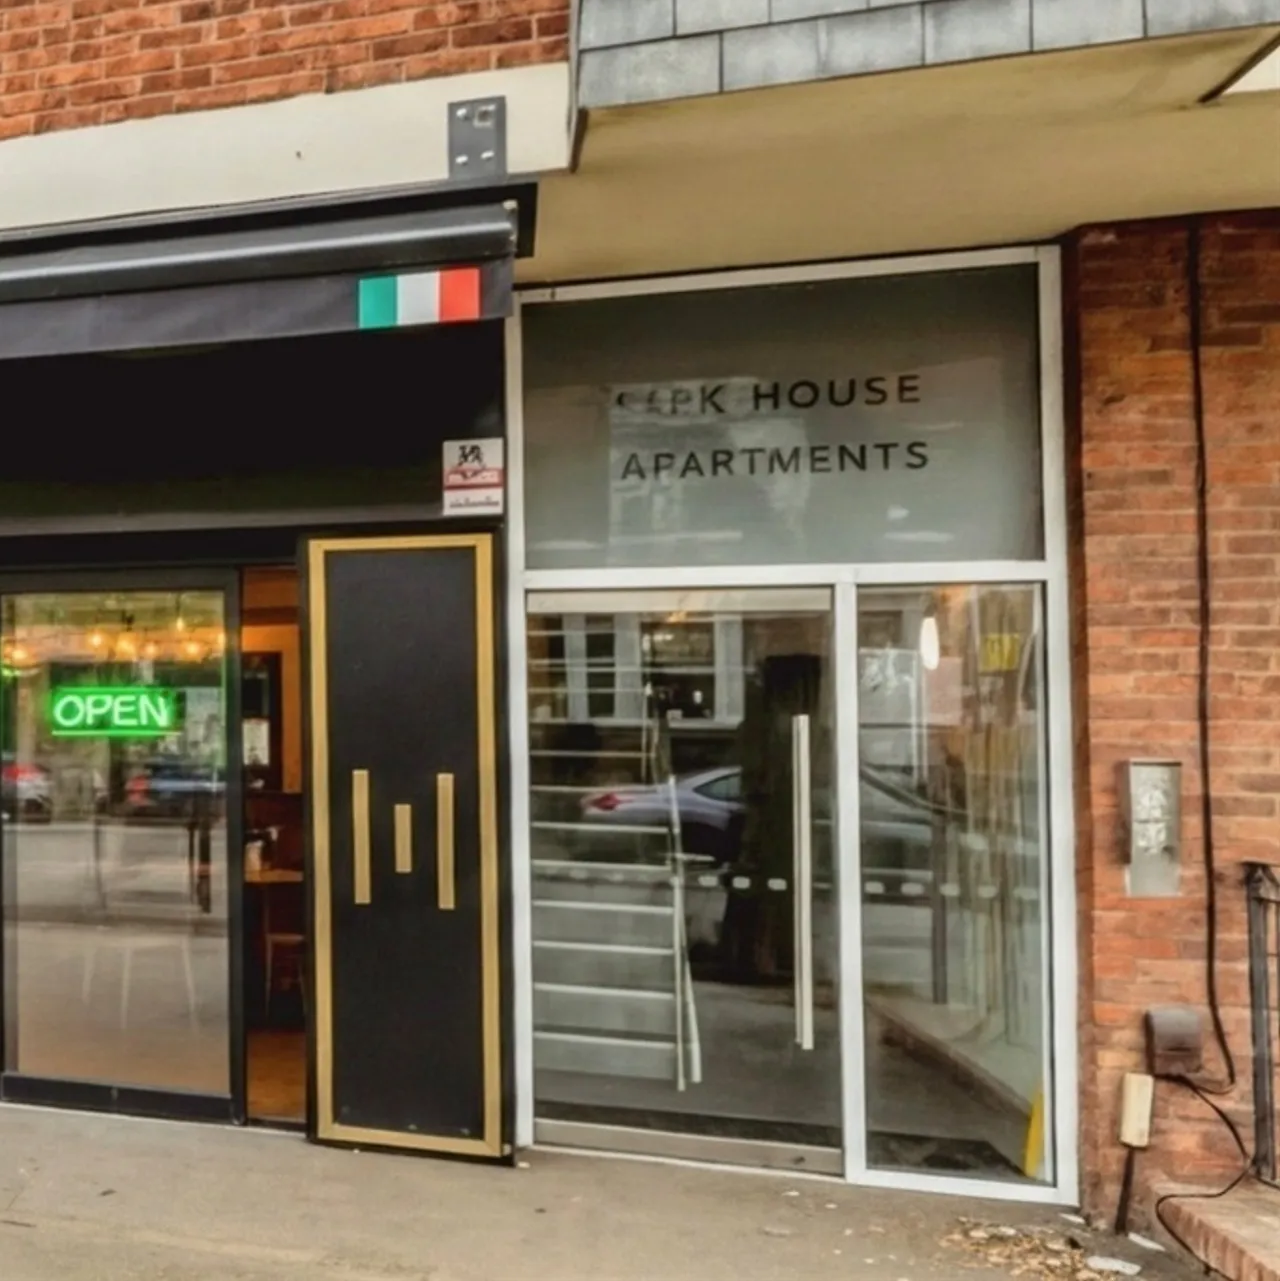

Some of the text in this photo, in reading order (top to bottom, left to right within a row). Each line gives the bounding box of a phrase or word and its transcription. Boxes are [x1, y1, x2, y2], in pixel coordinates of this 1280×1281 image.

[752, 375, 922, 411] HOUSE
[620, 441, 929, 481] APARTMENTS
[53, 694, 170, 728] OPEN
